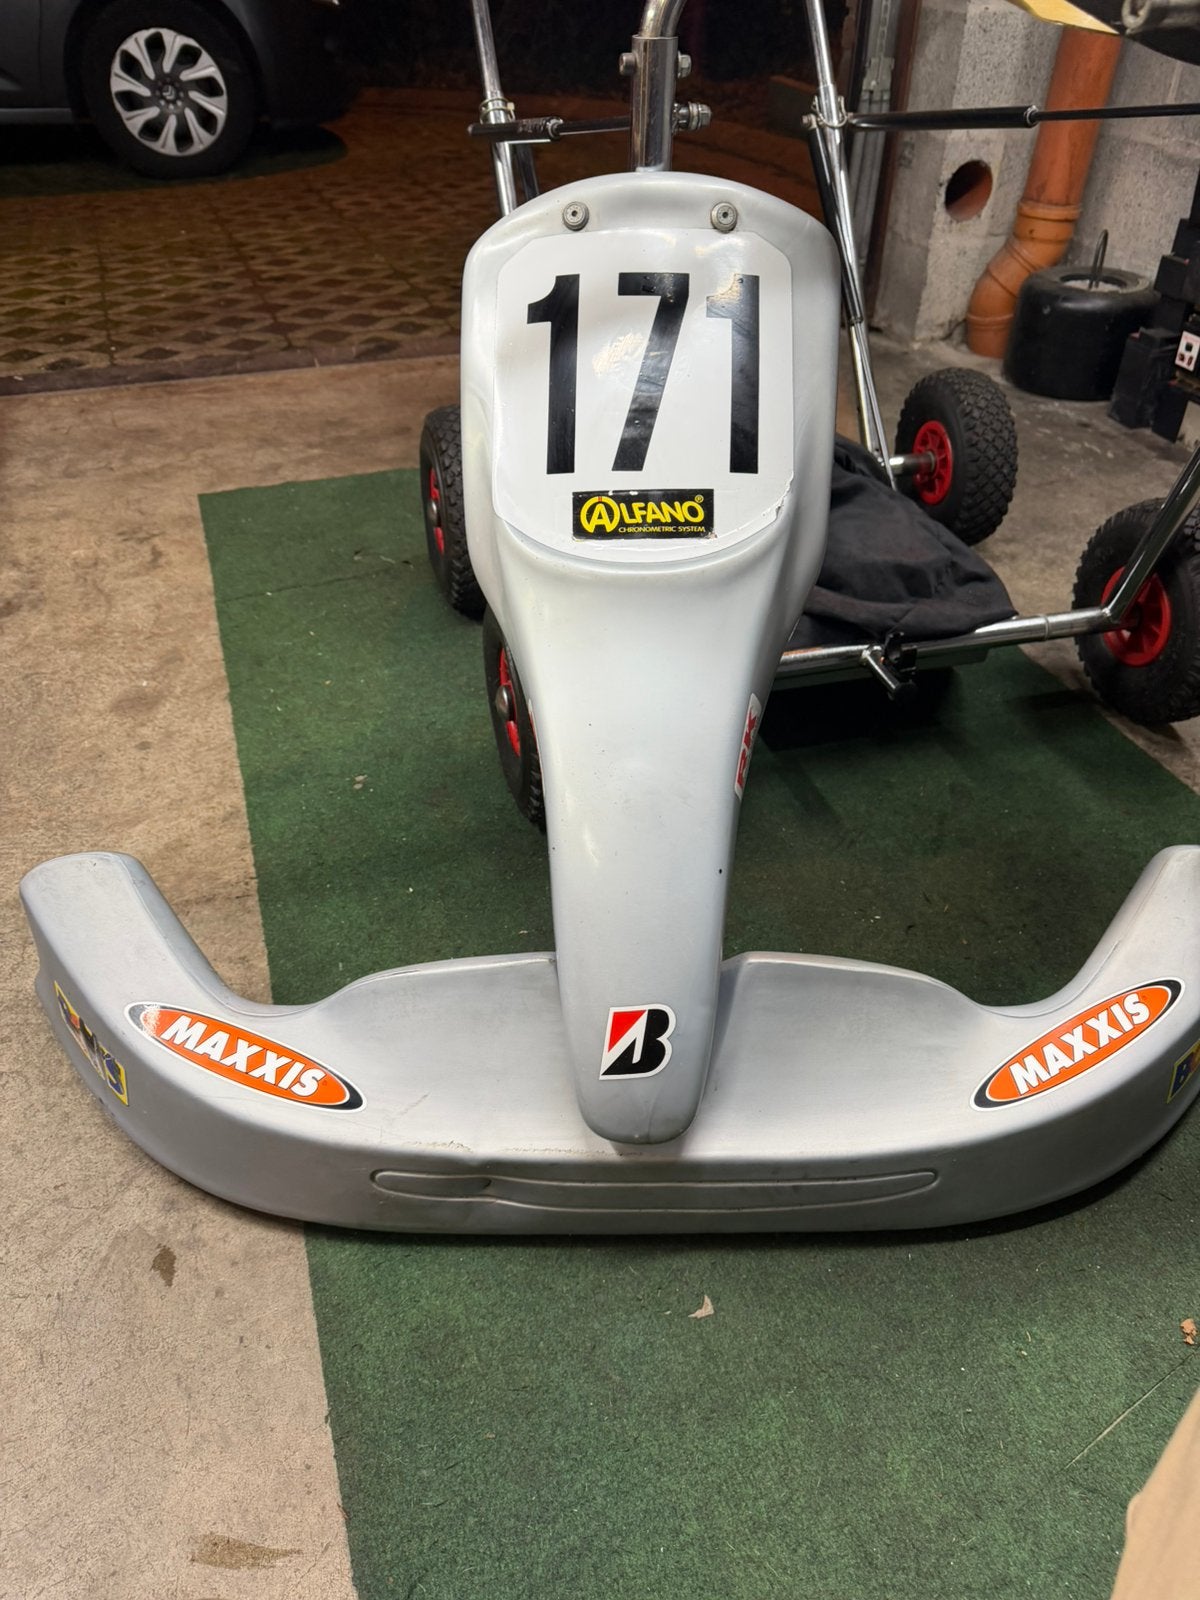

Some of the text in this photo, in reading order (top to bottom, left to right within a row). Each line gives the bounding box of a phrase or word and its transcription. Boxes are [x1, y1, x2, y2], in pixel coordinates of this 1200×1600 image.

[527, 272, 760, 474] 171
[618, 525, 677, 533] CHRONOMETRIC
[160, 1014, 327, 1097] MAXXIS
[1008, 992, 1151, 1096] MAXXIS
